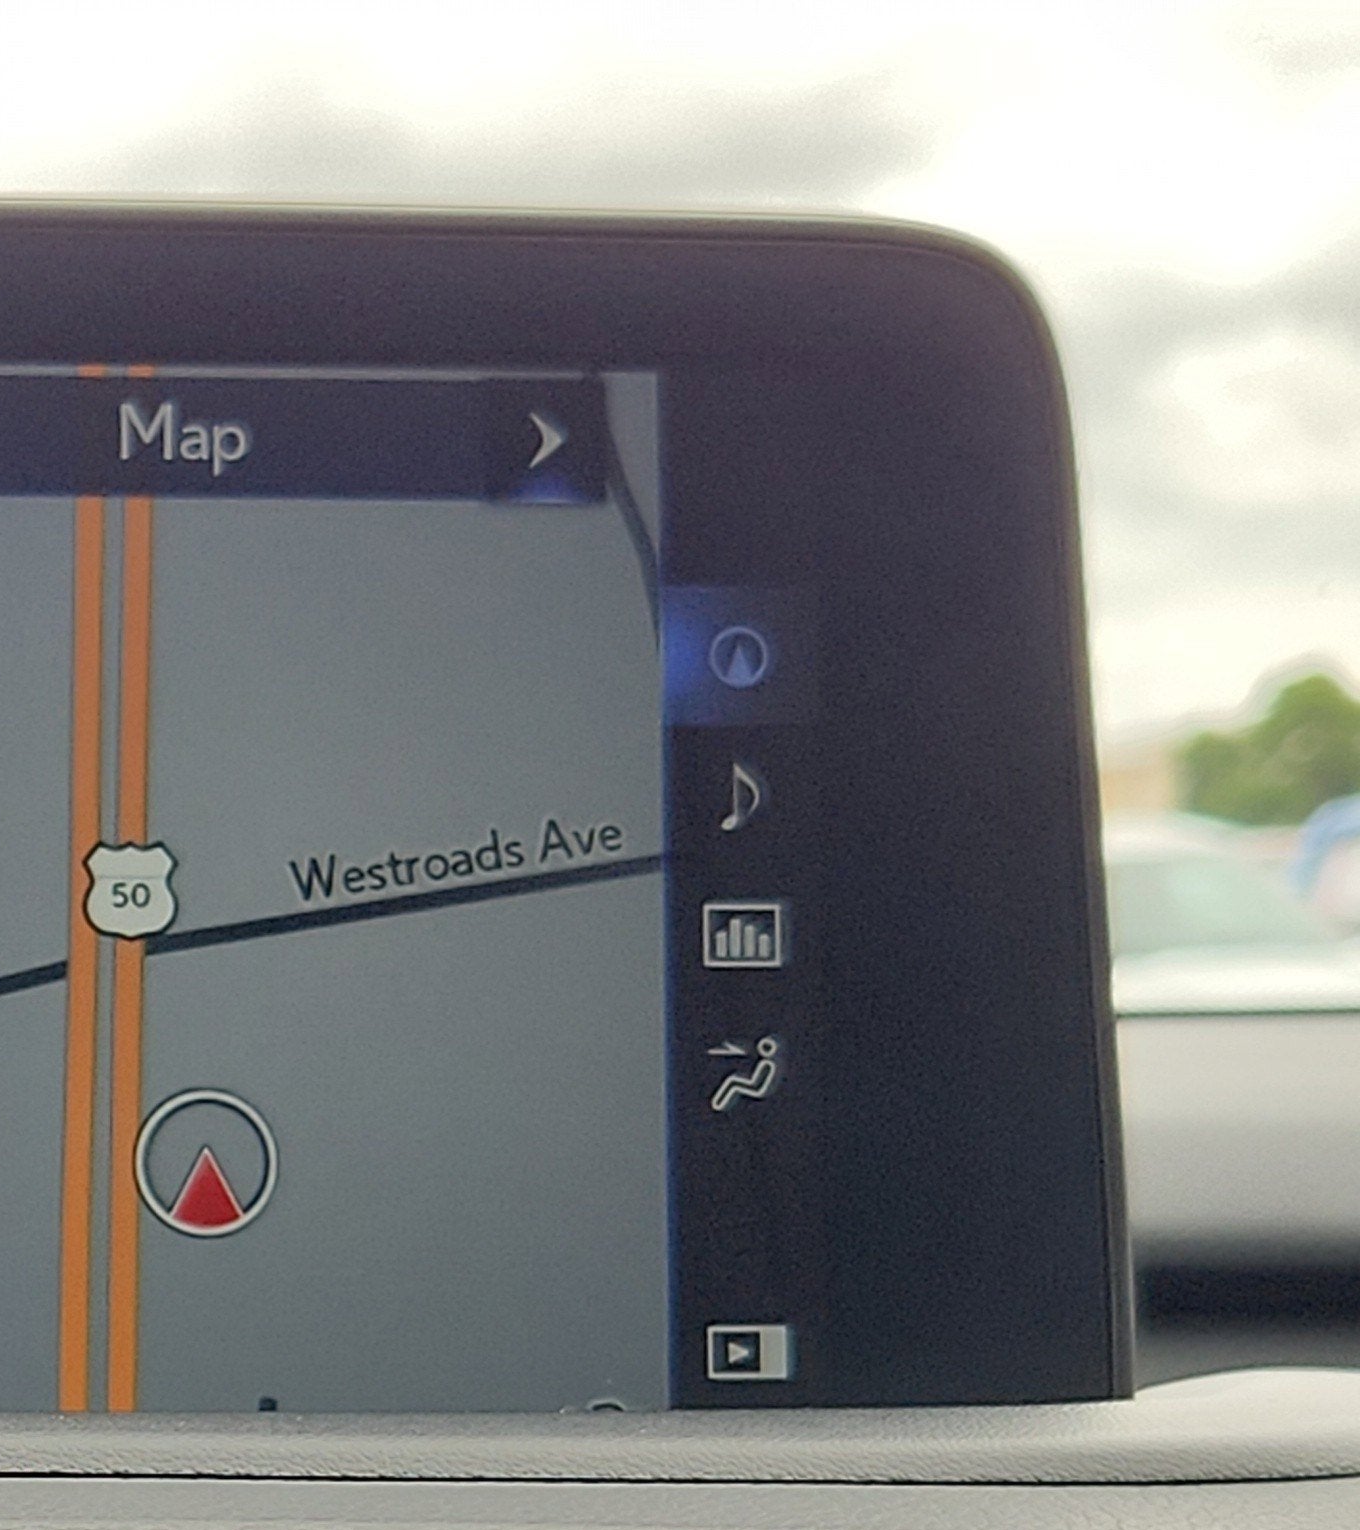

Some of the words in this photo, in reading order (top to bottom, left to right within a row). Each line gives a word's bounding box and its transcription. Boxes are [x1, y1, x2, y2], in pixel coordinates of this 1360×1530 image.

[119, 402, 249, 476] Map
[111, 882, 151, 909] 50
[288, 829, 526, 902] Westroads
[539, 818, 625, 864] Ave
